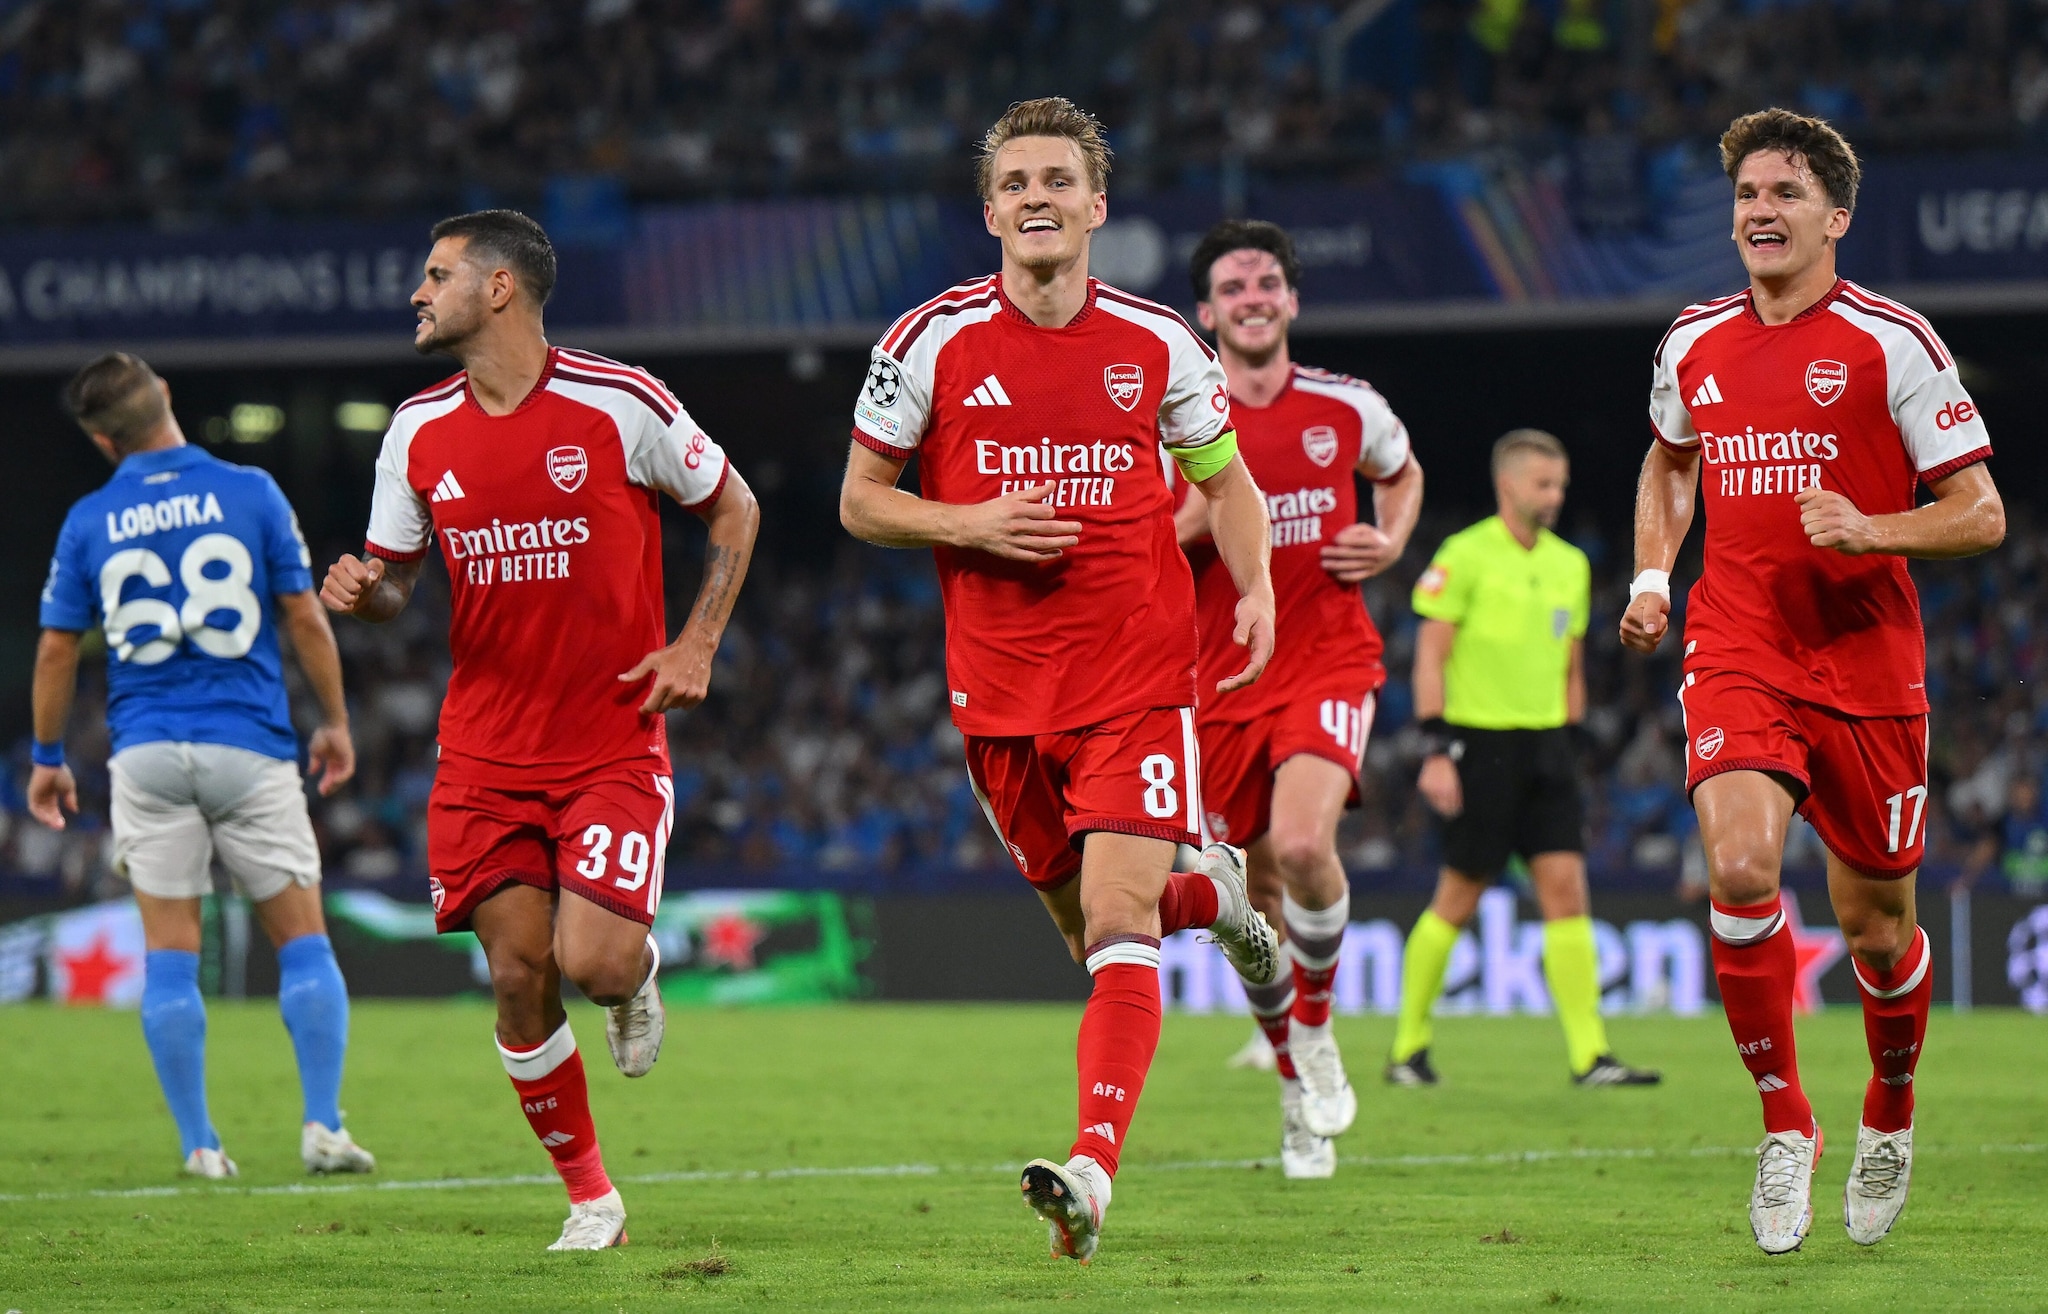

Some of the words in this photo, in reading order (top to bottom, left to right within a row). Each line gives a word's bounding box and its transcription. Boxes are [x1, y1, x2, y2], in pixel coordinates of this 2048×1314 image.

[1110, 371, 1140, 380] Arsenal
[1812, 366, 1842, 377] Arsenal
[552, 452, 582, 464] Arsenal
[974, 436, 1135, 475] Emirates
[1700, 425, 1839, 465] Emirates
[1720, 467, 1746, 497] FLY
[1751, 463, 1823, 496] BETTER
[106, 491, 225, 545] LOBOTKA
[1262, 486, 1338, 520] rates
[442, 515, 591, 560] Emirates
[467, 557, 495, 586] FLY
[501, 550, 571, 583] BETTER
[100, 532, 262, 666] 68
[1320, 698, 1361, 757] 41
[1139, 753, 1179, 819] 8
[1886, 785, 1928, 854] 17
[575, 824, 650, 892] 39
[1737, 1036, 1772, 1056] AFC
[524, 1096, 558, 1114] AFC
[1092, 1080, 1126, 1102] AFC
